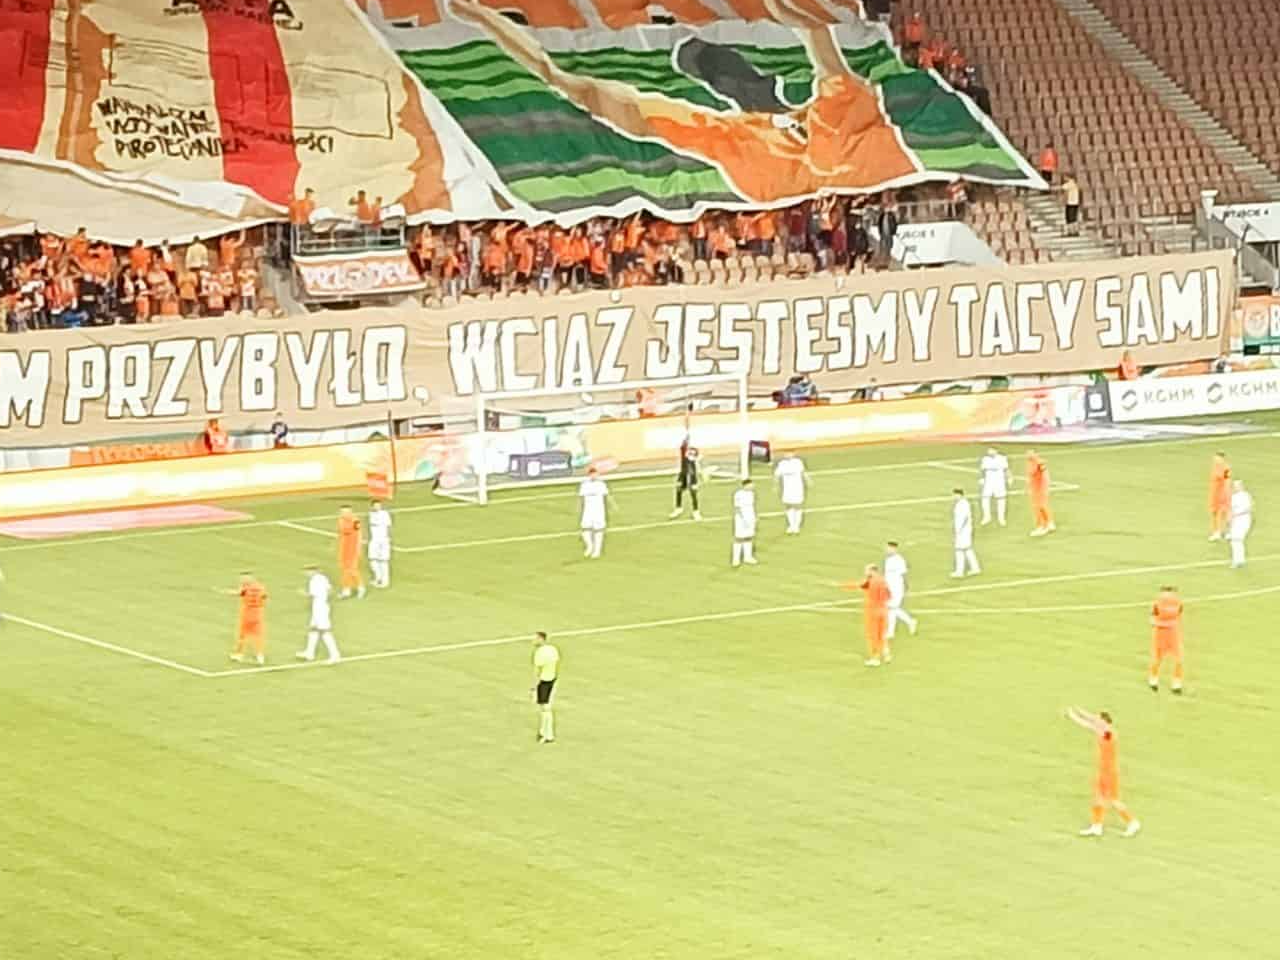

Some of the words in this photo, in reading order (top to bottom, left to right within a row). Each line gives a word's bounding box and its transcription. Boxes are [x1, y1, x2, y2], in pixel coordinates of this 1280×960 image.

[62, 325, 430, 424] PRZYBYŁO,
[447, 289, 636, 402] WCIĄŻ
[947, 279, 1086, 358] TACY
[1093, 266, 1221, 349] SAMI
[1144, 388, 1195, 403] KGHM
[1229, 380, 1279, 396] KGHM
